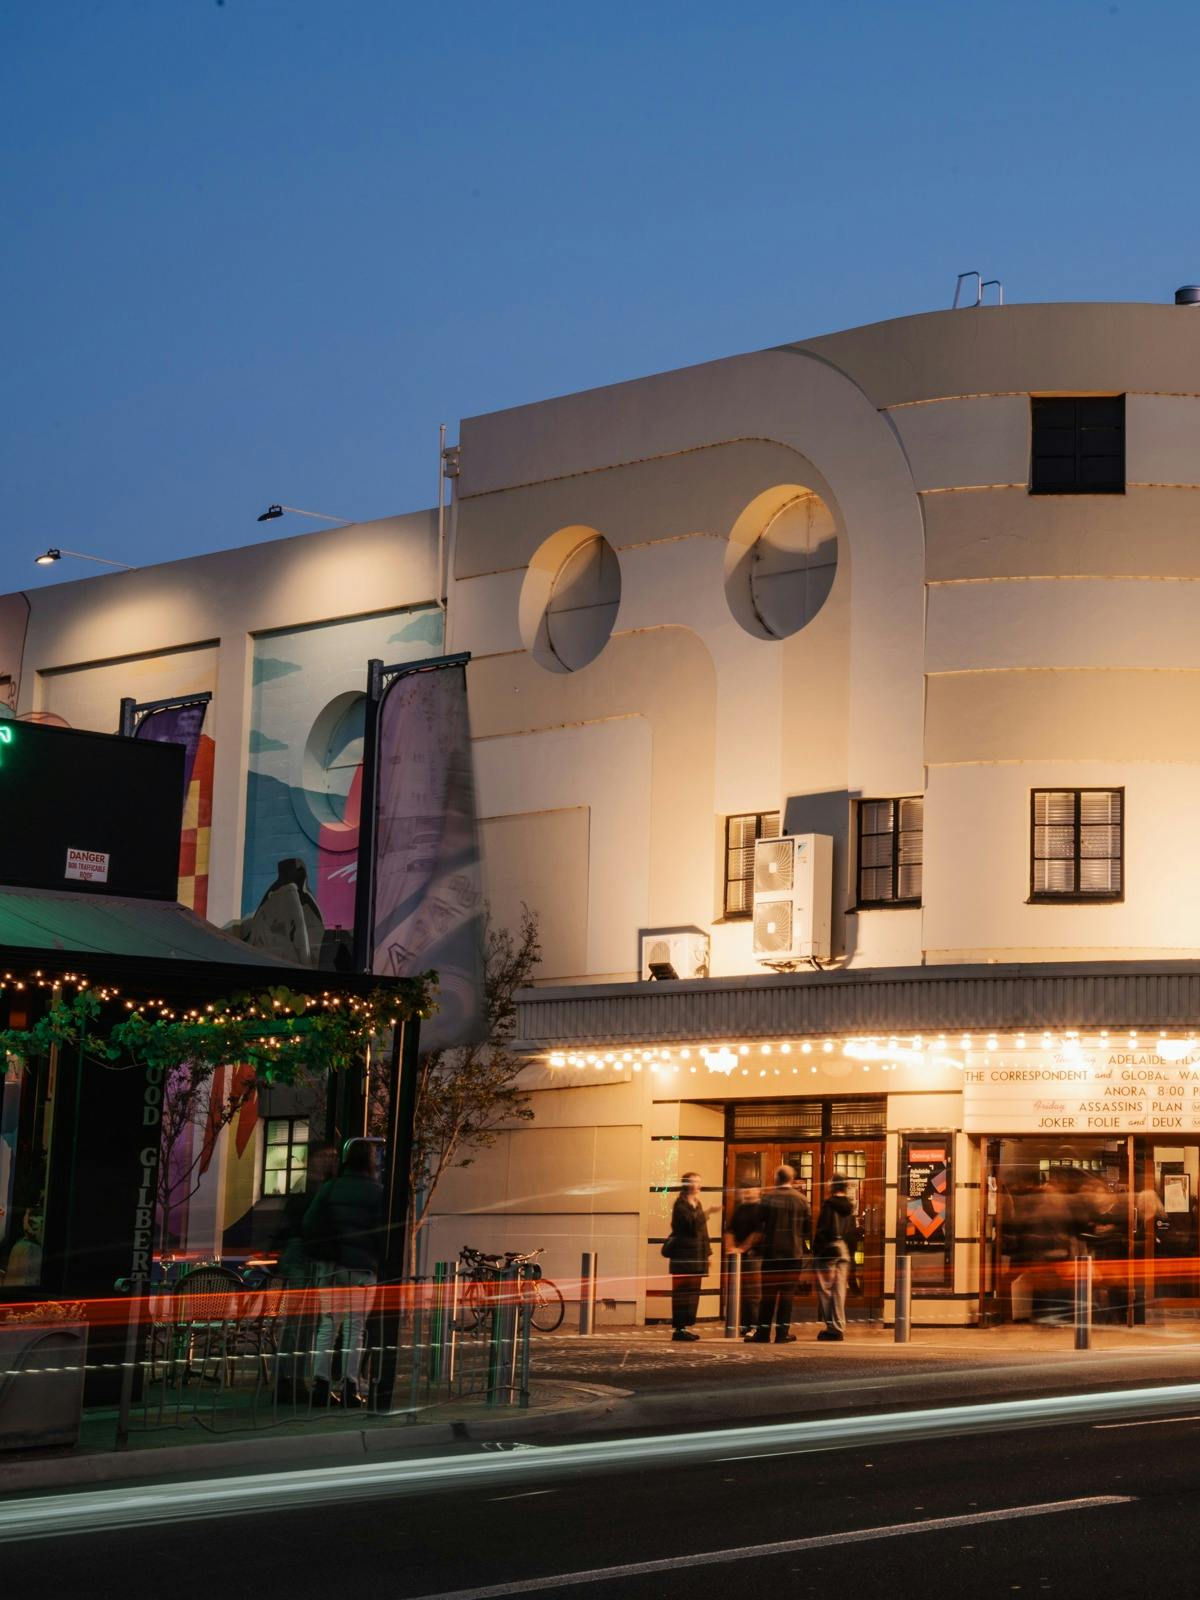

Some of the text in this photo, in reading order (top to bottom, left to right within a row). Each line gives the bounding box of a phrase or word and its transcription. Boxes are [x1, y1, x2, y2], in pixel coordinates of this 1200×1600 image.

[70, 851, 105, 863] DANGER
[1108, 1054, 1166, 1065] ADELAIDE
[965, 1071, 985, 1081] THE
[990, 1070, 1088, 1081] CORRESPONDENT
[1095, 1070, 1113, 1079] and
[1121, 1070, 1169, 1081] GLOBAL
[1104, 1086, 1146, 1096] ANORA
[1032, 1100, 1067, 1112] Friday
[1079, 1101, 1143, 1112] ASSASSINS
[1152, 1102, 1182, 1111] PLAN
[1087, 1117, 1120, 1127] FOLIE
[1128, 1117, 1146, 1126] and
[1152, 1117, 1182, 1127] DEUX
[132, 1067, 161, 1281] OOD GILBERT
